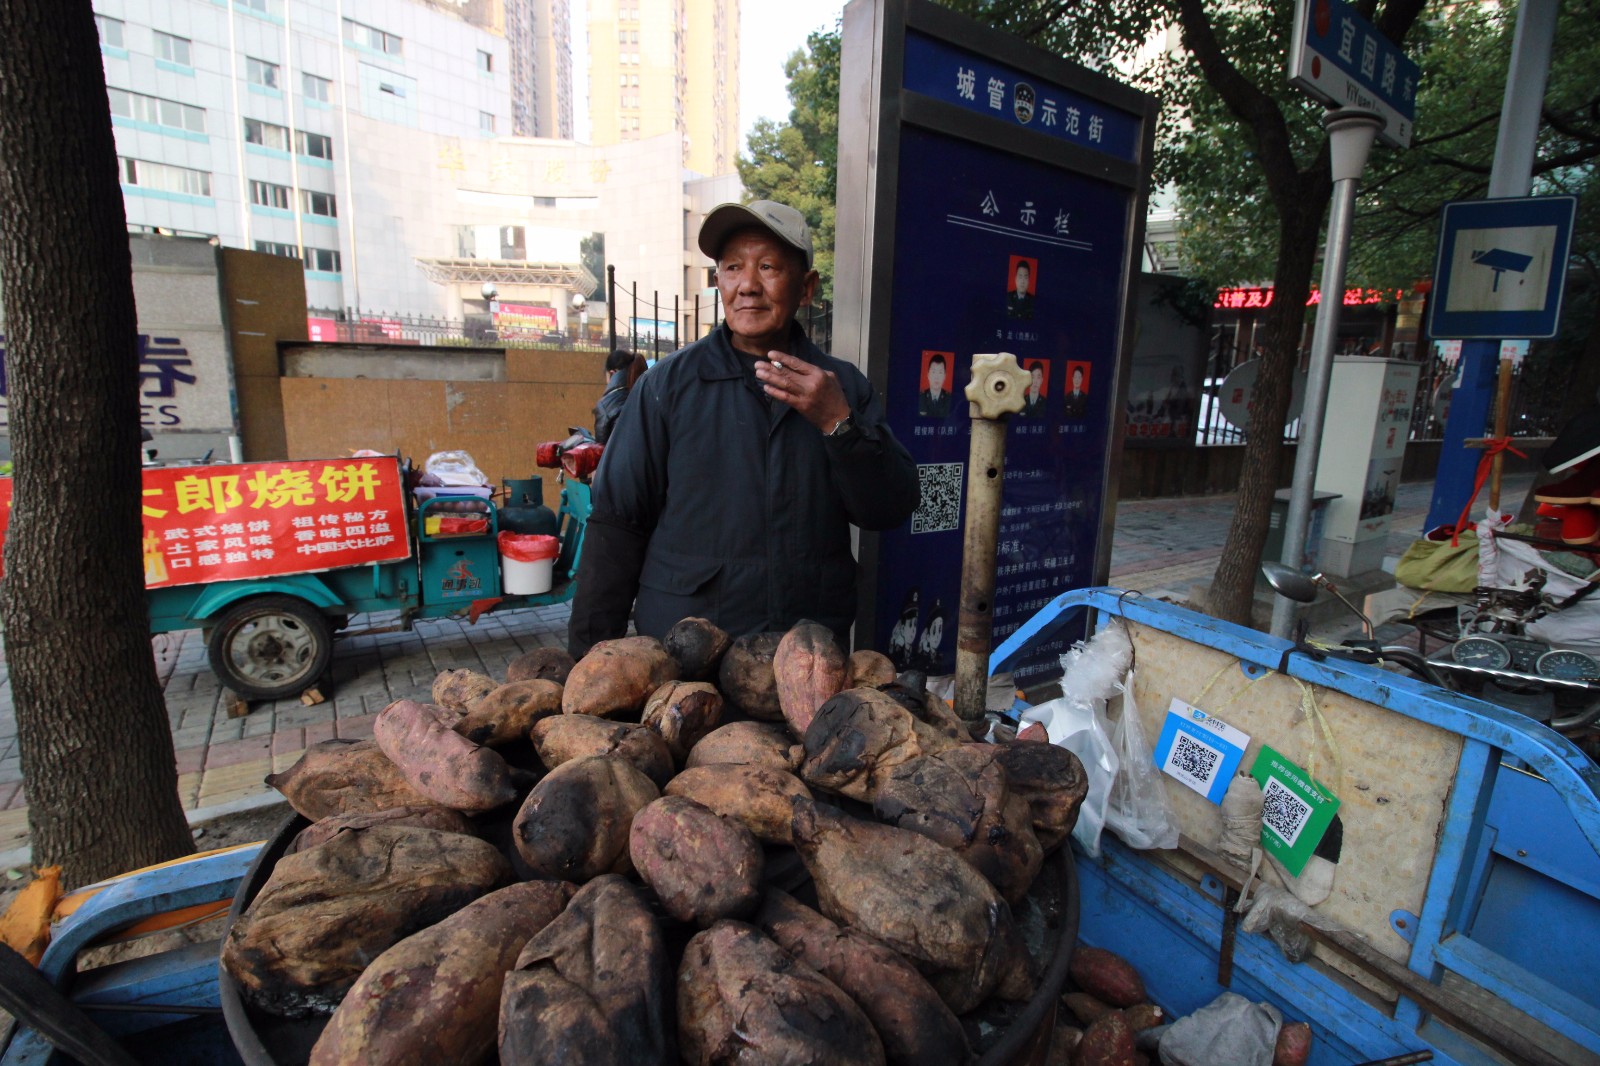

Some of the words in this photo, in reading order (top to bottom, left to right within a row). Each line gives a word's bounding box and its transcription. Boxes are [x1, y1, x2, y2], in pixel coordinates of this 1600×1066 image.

[1338, 16, 1398, 97] 宜园路
[1402, 75, 1414, 101] 东
[979, 189, 1071, 235] 公示栏
[163, 519, 271, 541] 武式烧饼
[291, 509, 389, 529] 祖传秘方
[166, 534, 273, 555] 土家风味
[294, 522, 391, 542] 香味四溢
[170, 548, 275, 569] 口感独特
[296, 535, 395, 555] 中国式比萨
[1270, 759, 1325, 805] 推荐使用微信支付
